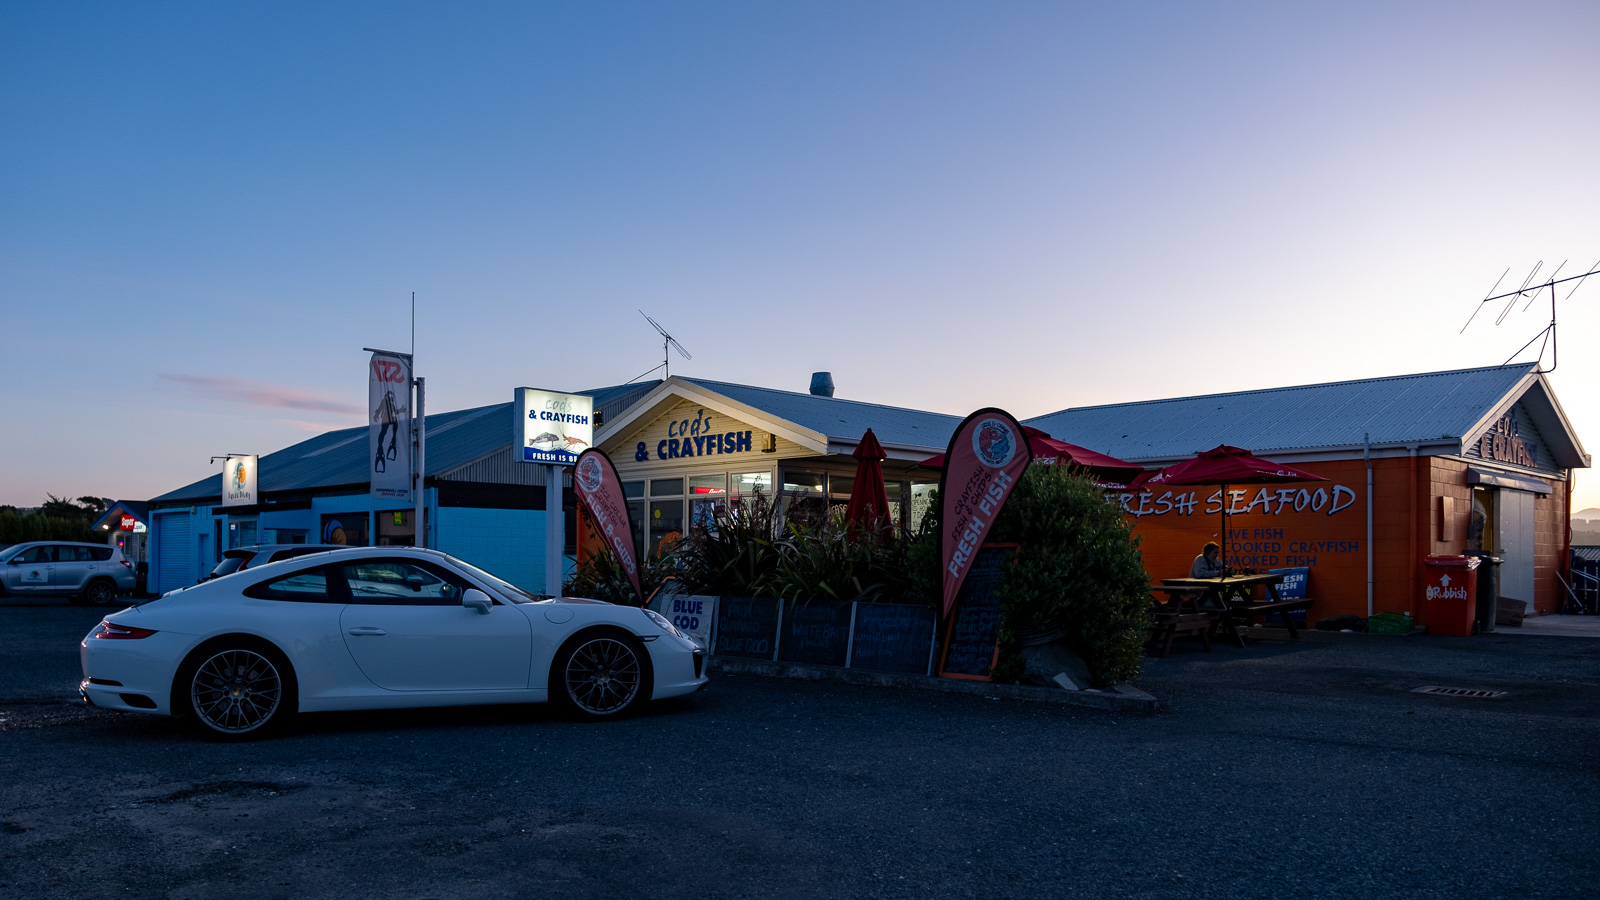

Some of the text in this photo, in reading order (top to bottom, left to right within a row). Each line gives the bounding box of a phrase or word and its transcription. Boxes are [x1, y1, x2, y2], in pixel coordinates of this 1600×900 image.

[528, 409, 588, 425] & CRAYFISH
[668, 409, 712, 443] cods
[532, 452, 578, 463] FRESH IS BE
[635, 430, 752, 462] & CRAYFISH
[1492, 434, 1538, 468] CRAYFISH
[954, 465, 985, 516] CRAYFISH
[1205, 484, 1356, 516] SEAFOOD
[595, 490, 618, 527] CRAYFISH
[600, 486, 627, 528] ICE CREAM
[951, 473, 992, 542] FISH & CHIPS
[585, 493, 607, 523] FISH
[605, 523, 614, 536] &
[613, 535, 636, 575] CHIPS
[947, 515, 985, 579] FRESH
[978, 470, 1013, 517] FISH
[1254, 528, 1283, 540] FISH
[1289, 541, 1359, 553] CRAYFISH
[1286, 555, 1317, 567] FISH
[1274, 582, 1297, 590] FISH
[1283, 574, 1303, 583] ESH
[1432, 586, 1467, 600] Rubbish
[673, 599, 703, 615] BLUE
[673, 615, 699, 630] COD
